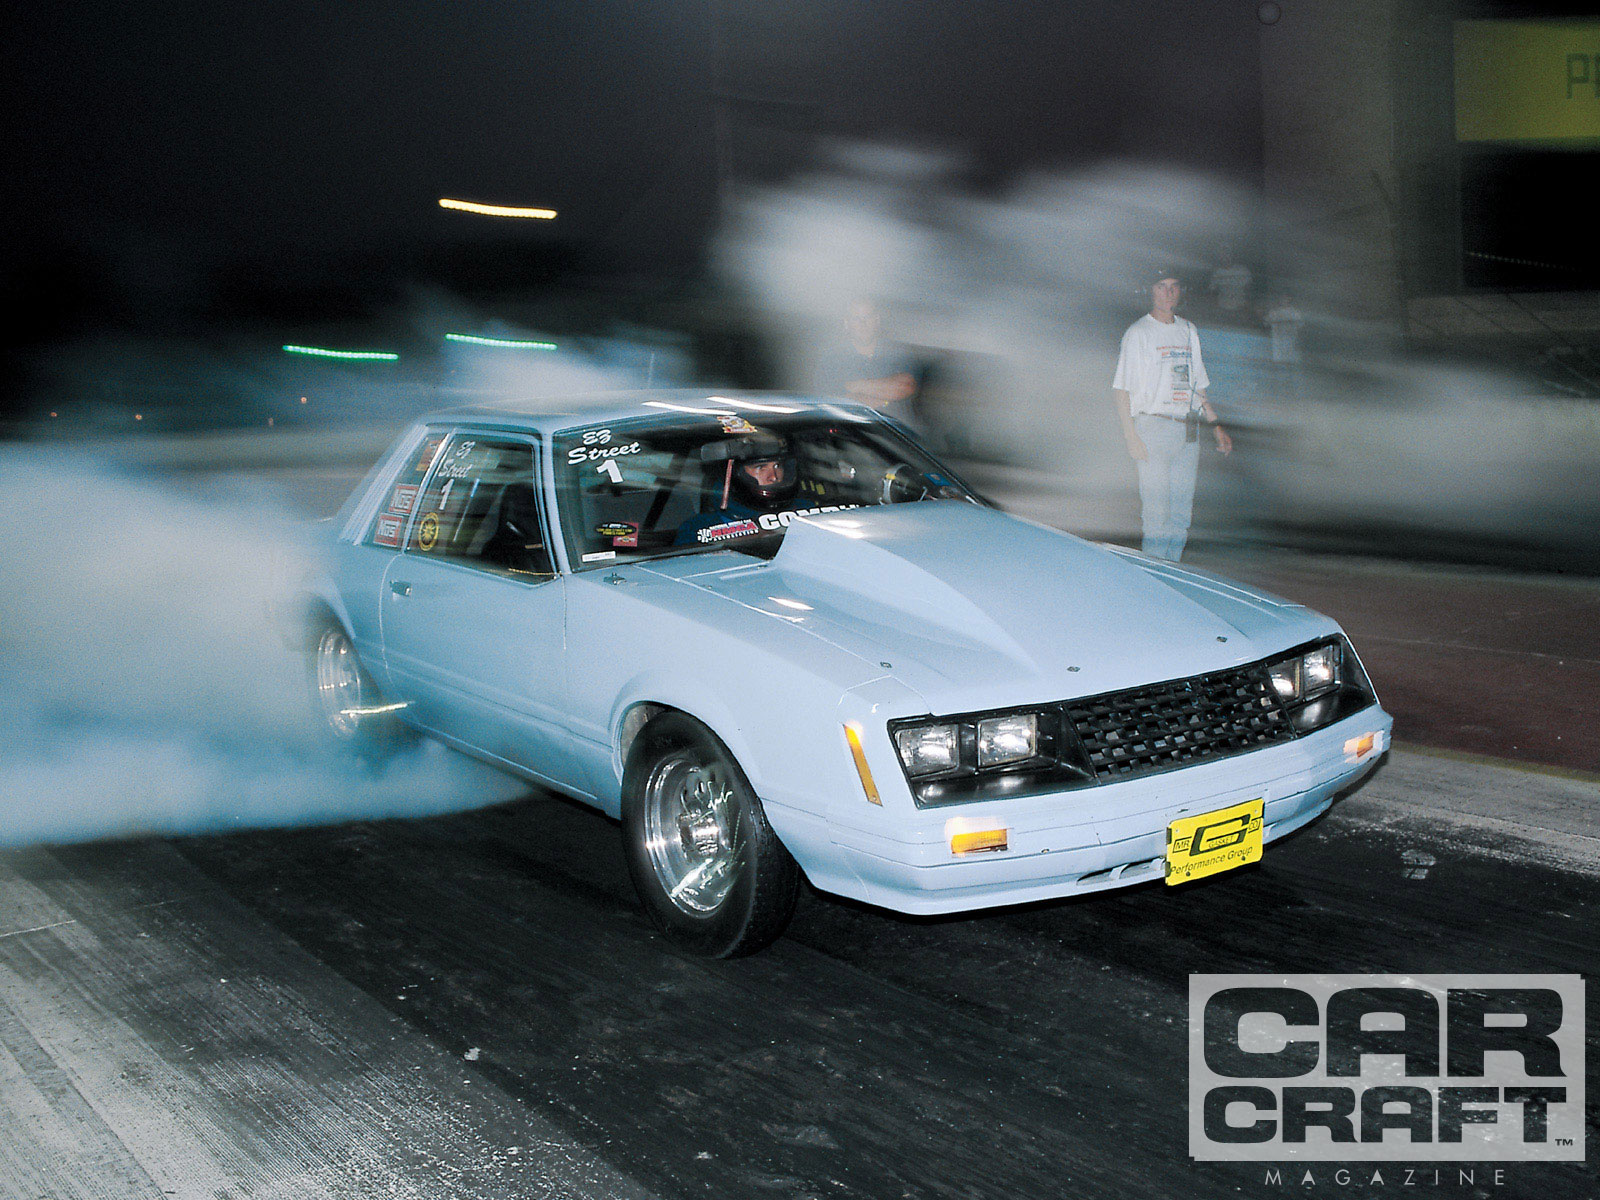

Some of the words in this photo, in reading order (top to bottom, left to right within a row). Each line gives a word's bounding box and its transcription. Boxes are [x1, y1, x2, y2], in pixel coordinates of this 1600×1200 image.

[1566, 52, 1600, 99] P
[582, 429, 611, 445] EZ
[568, 442, 641, 465] Street
[596, 459, 623, 483] 1
[440, 478, 454, 510] 1
[1175, 840, 1190, 851] MR
[1208, 835, 1234, 849] GASKET
[1227, 846, 1253, 860] Group
